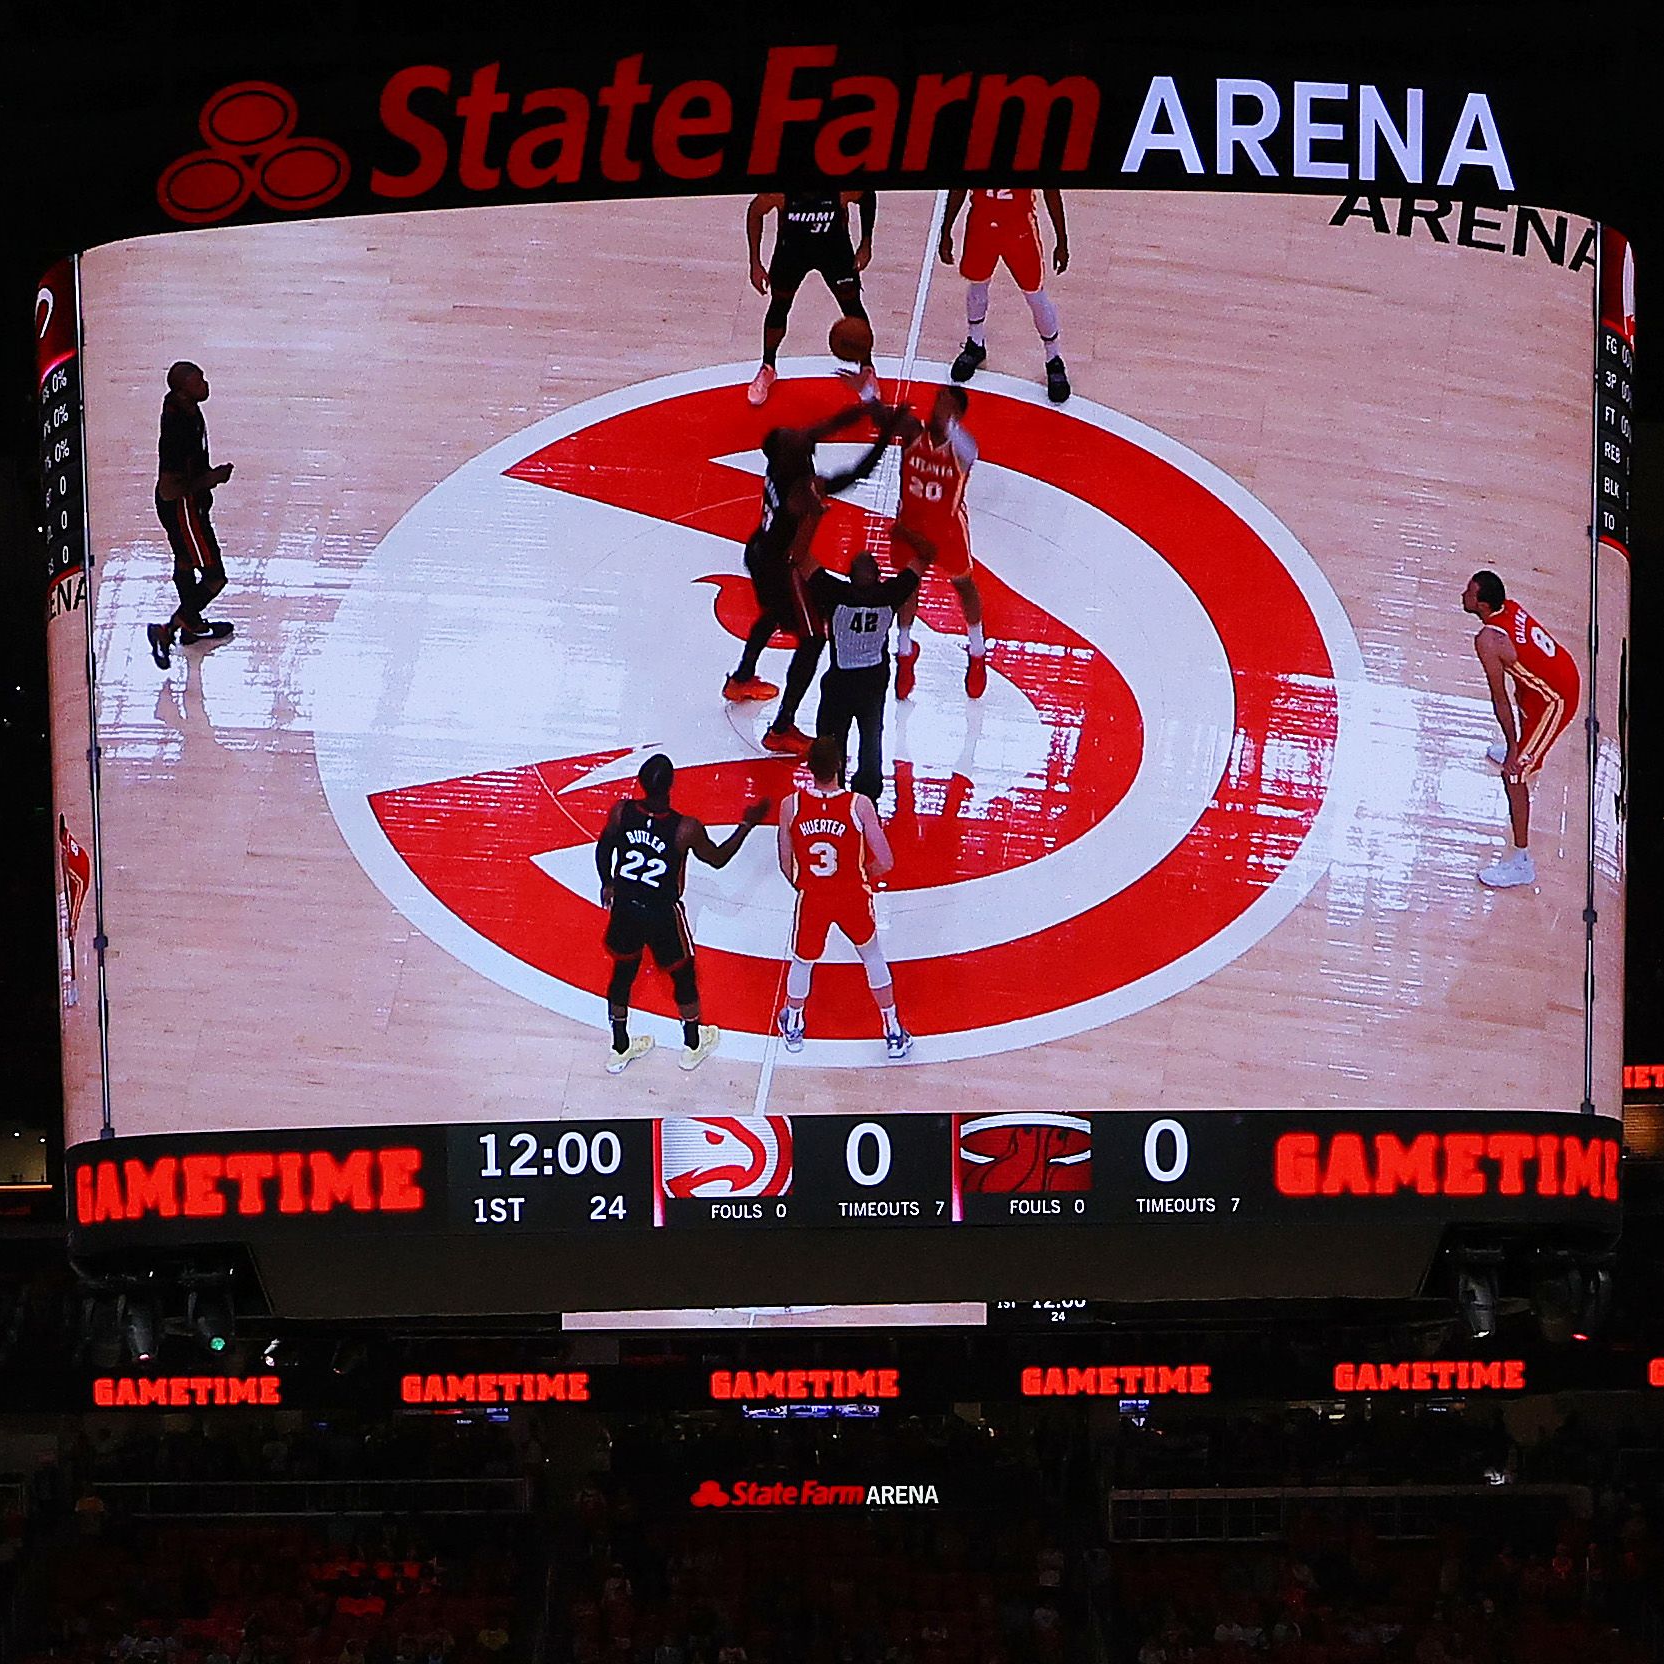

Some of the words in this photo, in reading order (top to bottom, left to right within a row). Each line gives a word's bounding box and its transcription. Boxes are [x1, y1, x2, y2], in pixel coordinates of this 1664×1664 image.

[1122, 76, 1514, 191] ARENA
[810, 222, 831, 233] 31
[1606, 335, 1617, 354] FG
[52, 368, 67, 392] 0%
[1605, 371, 1617, 389] 3P
[54, 403, 68, 427] 0%
[1605, 406, 1615, 425] FT
[54, 438, 70, 462] 0%
[1604, 442, 1620, 464] REB
[60, 476, 67, 495] 0
[909, 476, 942, 501] 20
[1604, 477, 1619, 499] BLK
[61, 511, 68, 529] 0
[1604, 512, 1615, 530] TO
[62, 546, 69, 563] 0
[849, 612, 879, 634] 42
[1531, 627, 1556, 658] 8
[799, 818, 847, 838] HUERTER
[625, 829, 667, 854] BUTLER
[619, 849, 668, 888] 22
[808, 841, 838, 877] 3
[479, 1130, 622, 1177] 12:00
[846, 1122, 891, 1186] 0
[1141, 1119, 1189, 1181] 0
[473, 1197, 526, 1223] 1ST
[590, 1195, 627, 1220] 24
[711, 1203, 763, 1219] FOULS
[775, 1203, 787, 1218] 0
[837, 1201, 920, 1217] TIMEOUTS
[935, 1200, 945, 1216] 7
[1009, 1199, 1061, 1215] FOULS
[1074, 1199, 1085, 1214] 0
[1135, 1197, 1216, 1213] TIMEOUTS
[1230, 1197, 1241, 1212] 7
[1050, 1311, 1066, 1322] 24
[711, 1369, 899, 1399] GAMETIME
[1021, 1365, 1211, 1396] GAMETIME
[1334, 1360, 1525, 1391] GAMETIME
[93, 1376, 281, 1406] GAMETIME
[401, 1372, 589, 1403] GAMETIME
[865, 1484, 940, 1505] ARENA
